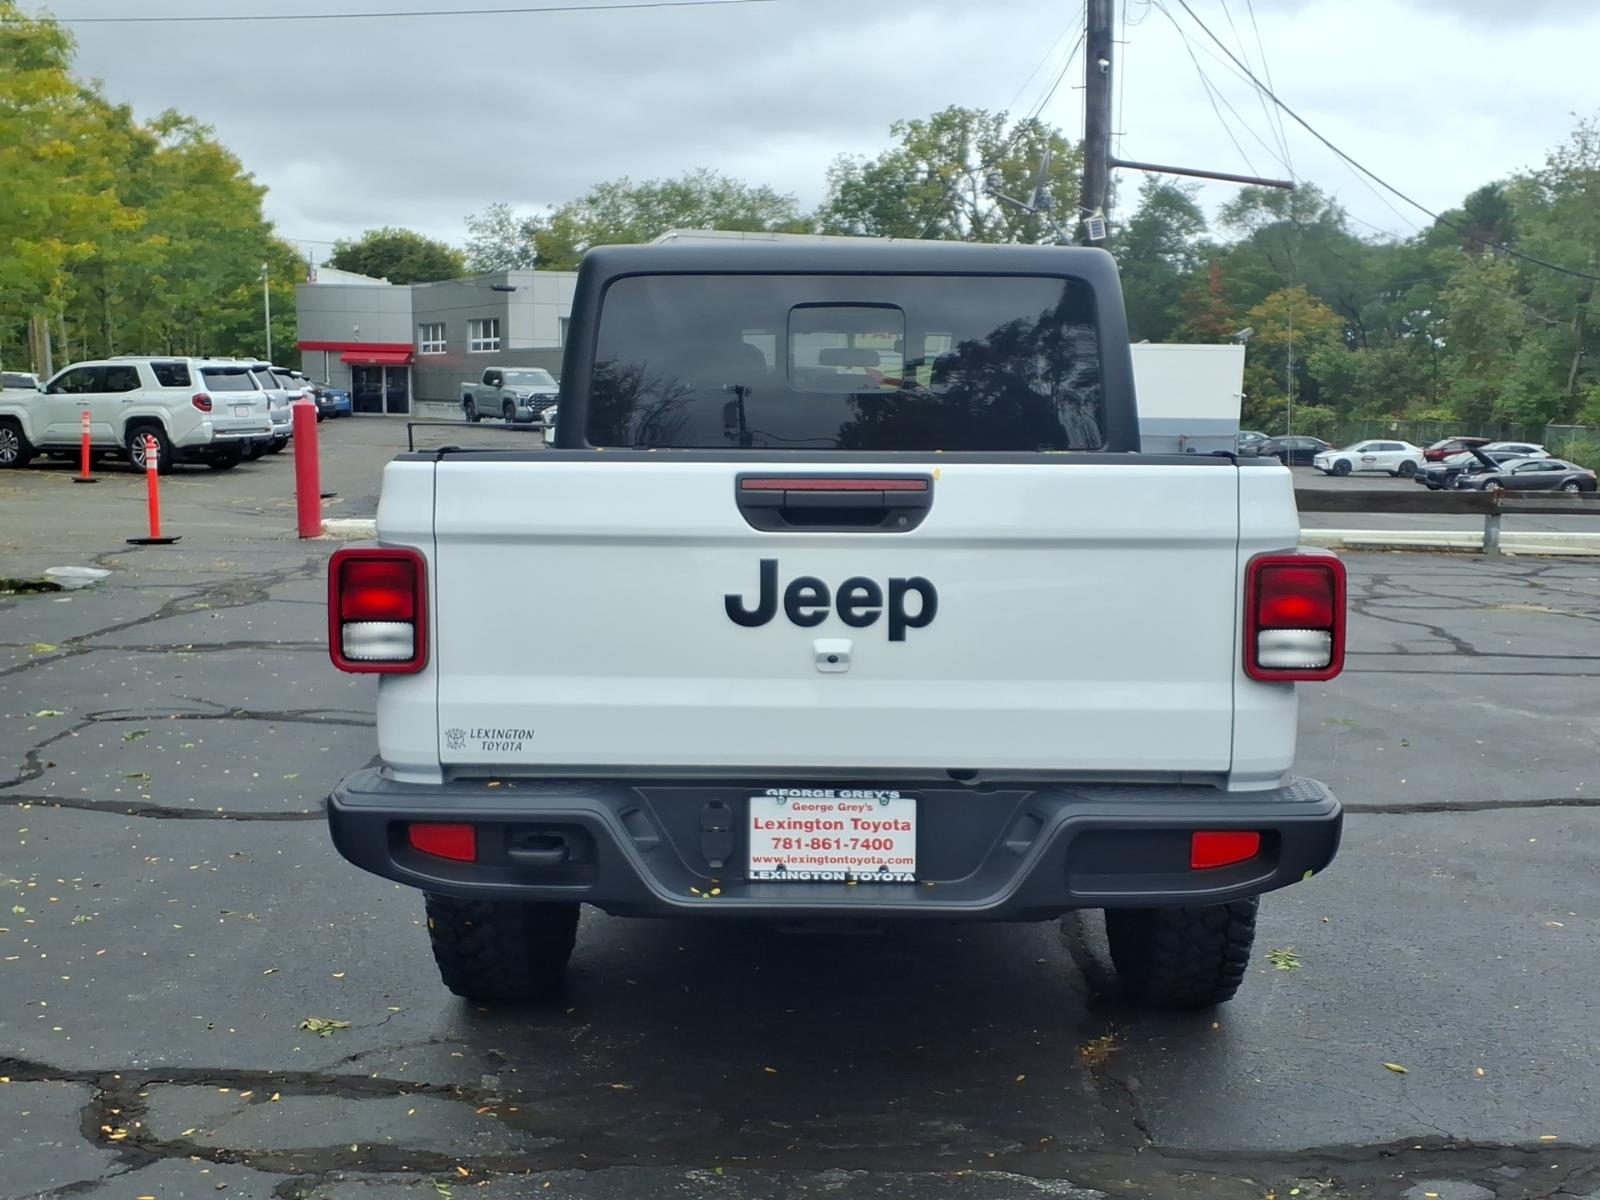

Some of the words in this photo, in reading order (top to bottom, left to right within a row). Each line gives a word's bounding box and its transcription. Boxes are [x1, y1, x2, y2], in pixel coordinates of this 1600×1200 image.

[724, 558, 938, 642] Jeep
[470, 728, 535, 739] LEXINGTON
[482, 741, 523, 751] TOYOTA
[766, 789, 835, 798] GEORGE
[840, 790, 900, 799] GREY'S
[792, 802, 834, 812] George
[838, 803, 873, 813] Grey's
[753, 817, 844, 833] Lexington
[850, 818, 912, 833] Toyota
[771, 837, 894, 851] 781-861-7400
[752, 855, 914, 866] www.lexingtontoyota.com
[749, 871, 845, 881] LEXINGTON
[850, 872, 916, 882] TOYOTA
